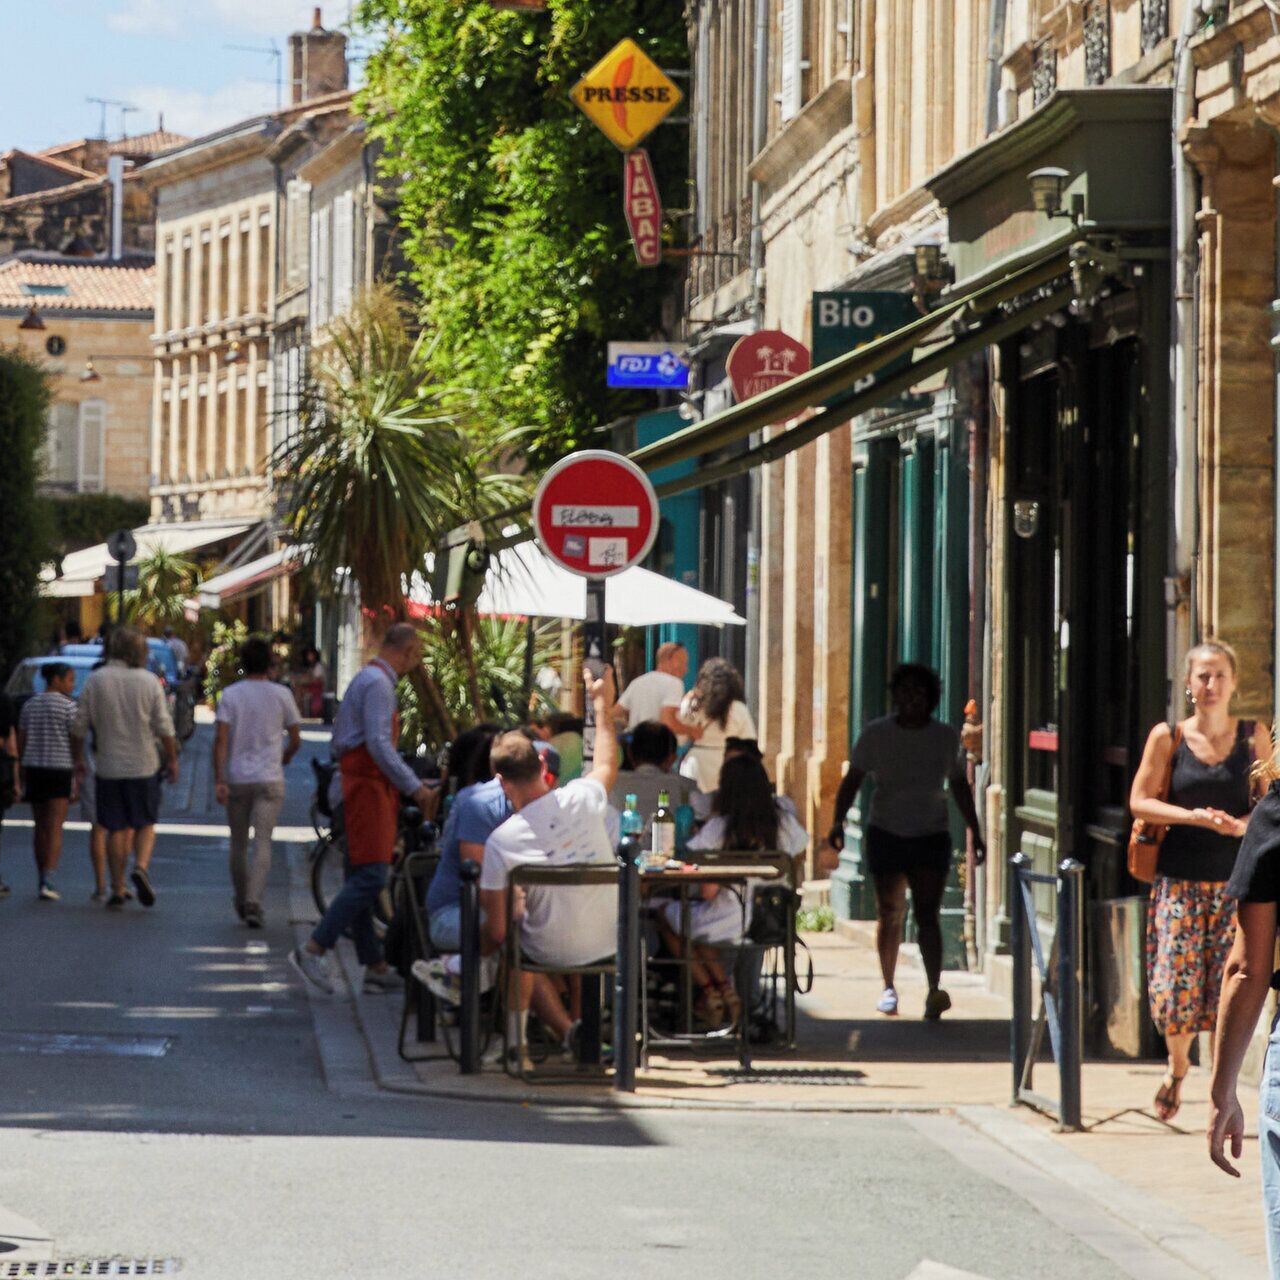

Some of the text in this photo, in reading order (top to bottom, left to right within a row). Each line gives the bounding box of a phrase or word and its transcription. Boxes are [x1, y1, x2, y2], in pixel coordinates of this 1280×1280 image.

[583, 86, 671, 103] PRESSE
[630, 154, 657, 259] TABAC
[819, 298, 875, 327] Bio
[619, 356, 652, 373] FDJ
